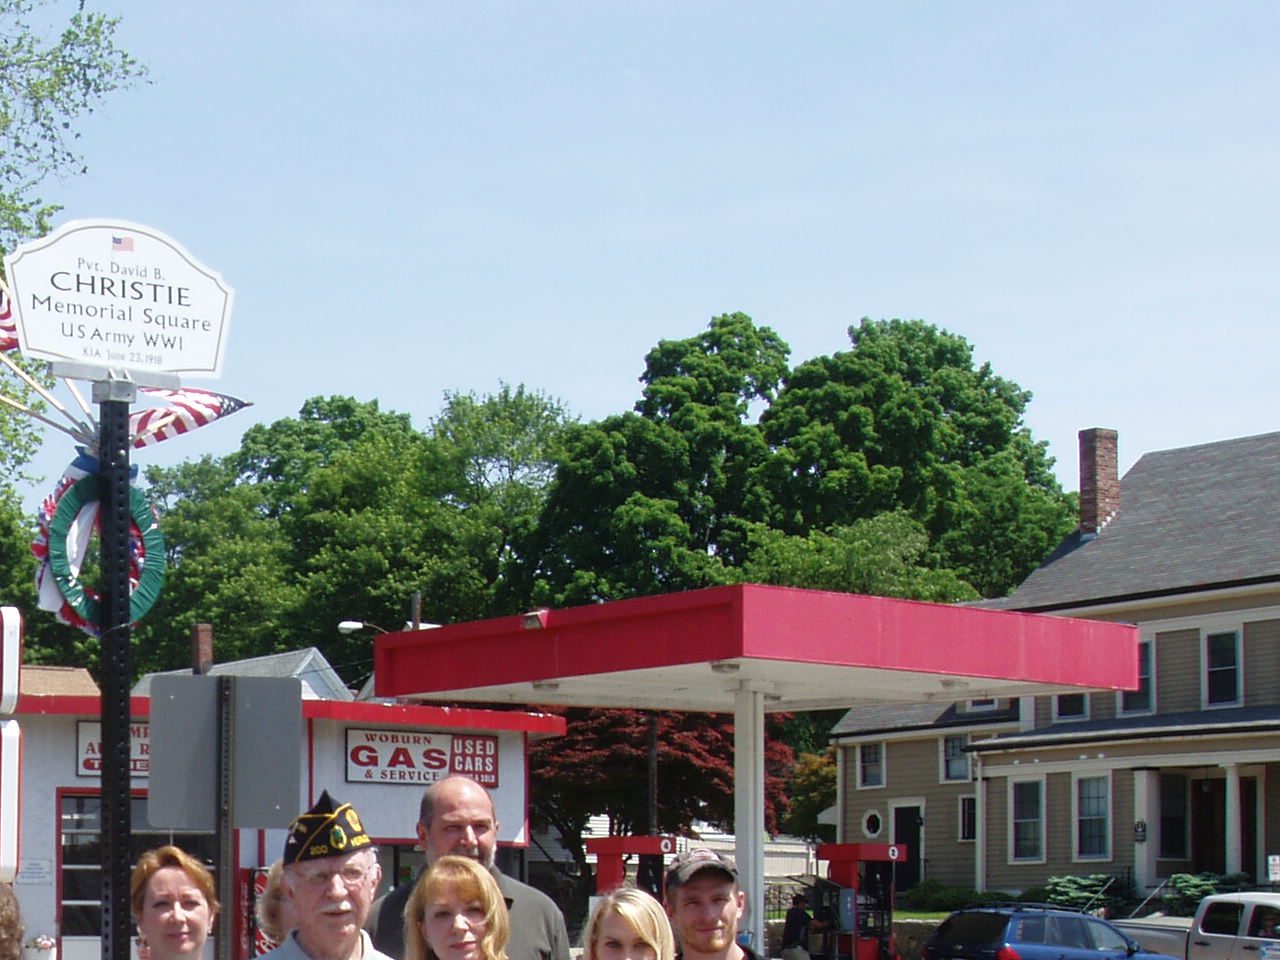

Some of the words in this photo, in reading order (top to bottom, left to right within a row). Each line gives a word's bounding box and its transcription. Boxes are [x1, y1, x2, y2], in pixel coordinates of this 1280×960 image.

[78, 257, 104, 272] Pvt.
[110, 261, 147, 278] David
[154, 267, 165, 280] B.
[50, 271, 191, 307] CHRISTIE
[32, 293, 132, 322] Memorial
[143, 308, 211, 332] Square
[143, 332, 183, 351] WWI
[83, 347, 101, 358] KIA
[364, 733, 432, 744] WOBURN
[454, 739, 495, 755] USED
[350, 745, 447, 770] GAS
[454, 756, 494, 772] CARS
[364, 770, 373, 779] &
[380, 770, 439, 782] SERVICE
